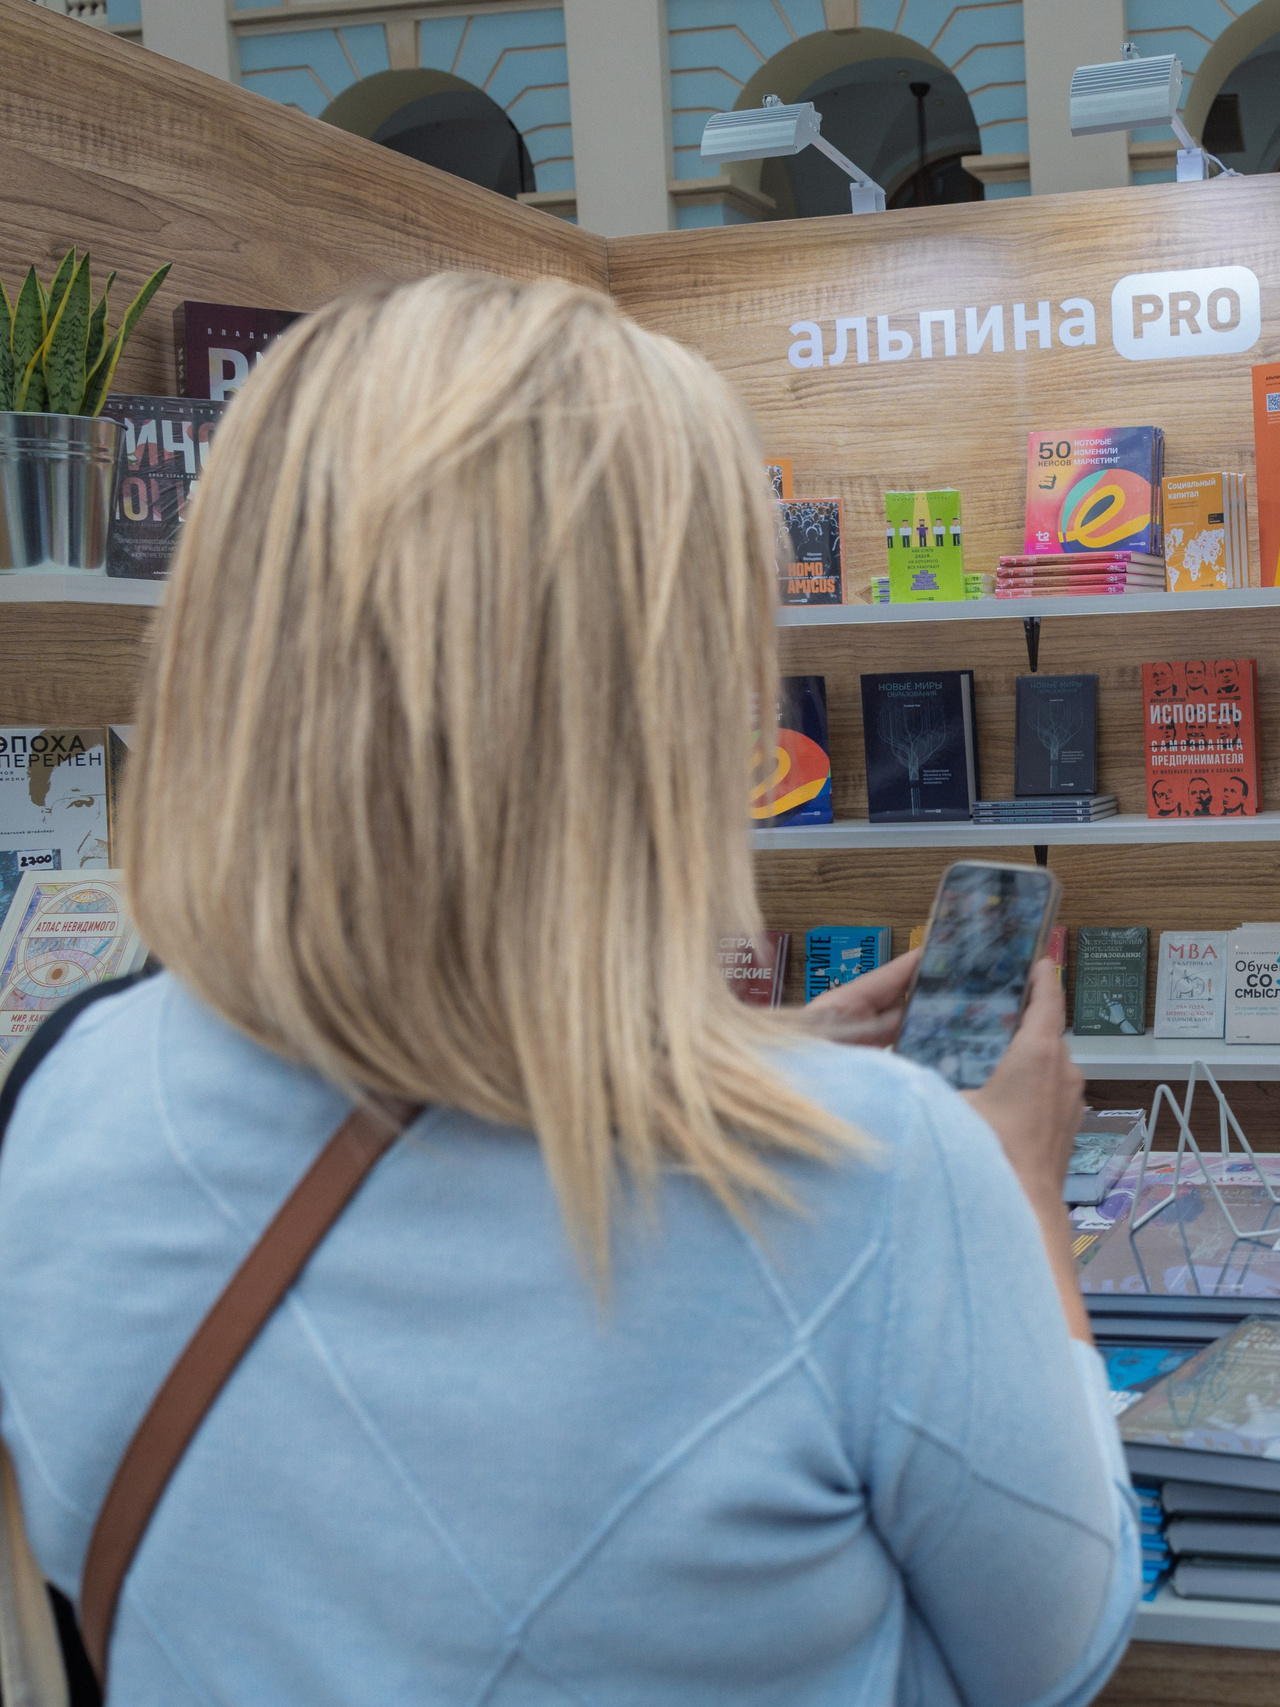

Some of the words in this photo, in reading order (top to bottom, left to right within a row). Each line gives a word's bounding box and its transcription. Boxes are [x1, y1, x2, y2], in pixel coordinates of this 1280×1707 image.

[1132, 287, 1241, 340] PRO
[787, 298, 1096, 369] альпина
[1074, 438, 1112, 446] КОТОРЫЕ
[1039, 441, 1071, 459] 50
[1074, 448, 1118, 456] ИЗМЕНИЛИ
[1038, 459, 1071, 467] КЕЙСОВ
[1073, 457, 1120, 466] МАРКЕТИНГ
[1167, 478, 1216, 490] Социальный
[1168, 491, 1199, 499] капитал
[787, 562, 823, 576] HOMO
[787, 578, 836, 594] AMICUS
[878, 683, 912, 691] НОВЫЕ
[915, 682, 942, 690] МИРЫ
[1150, 703, 1242, 724] ИСПОВЕДЬ
[1151, 738, 1243, 752] САМОЗВАНЦА
[1152, 753, 1244, 766] ПРЕДПРИНИМАТЕЛЯ
[20, 855, 52, 867] 2700
[35, 922, 61, 932] АТЛАС
[62, 921, 115, 933] НЕВИДИМОГО
[1168, 944, 1218, 959] MBA
[1246, 974, 1273, 988] СО
[11, 1014, 27, 1022] МИР,
